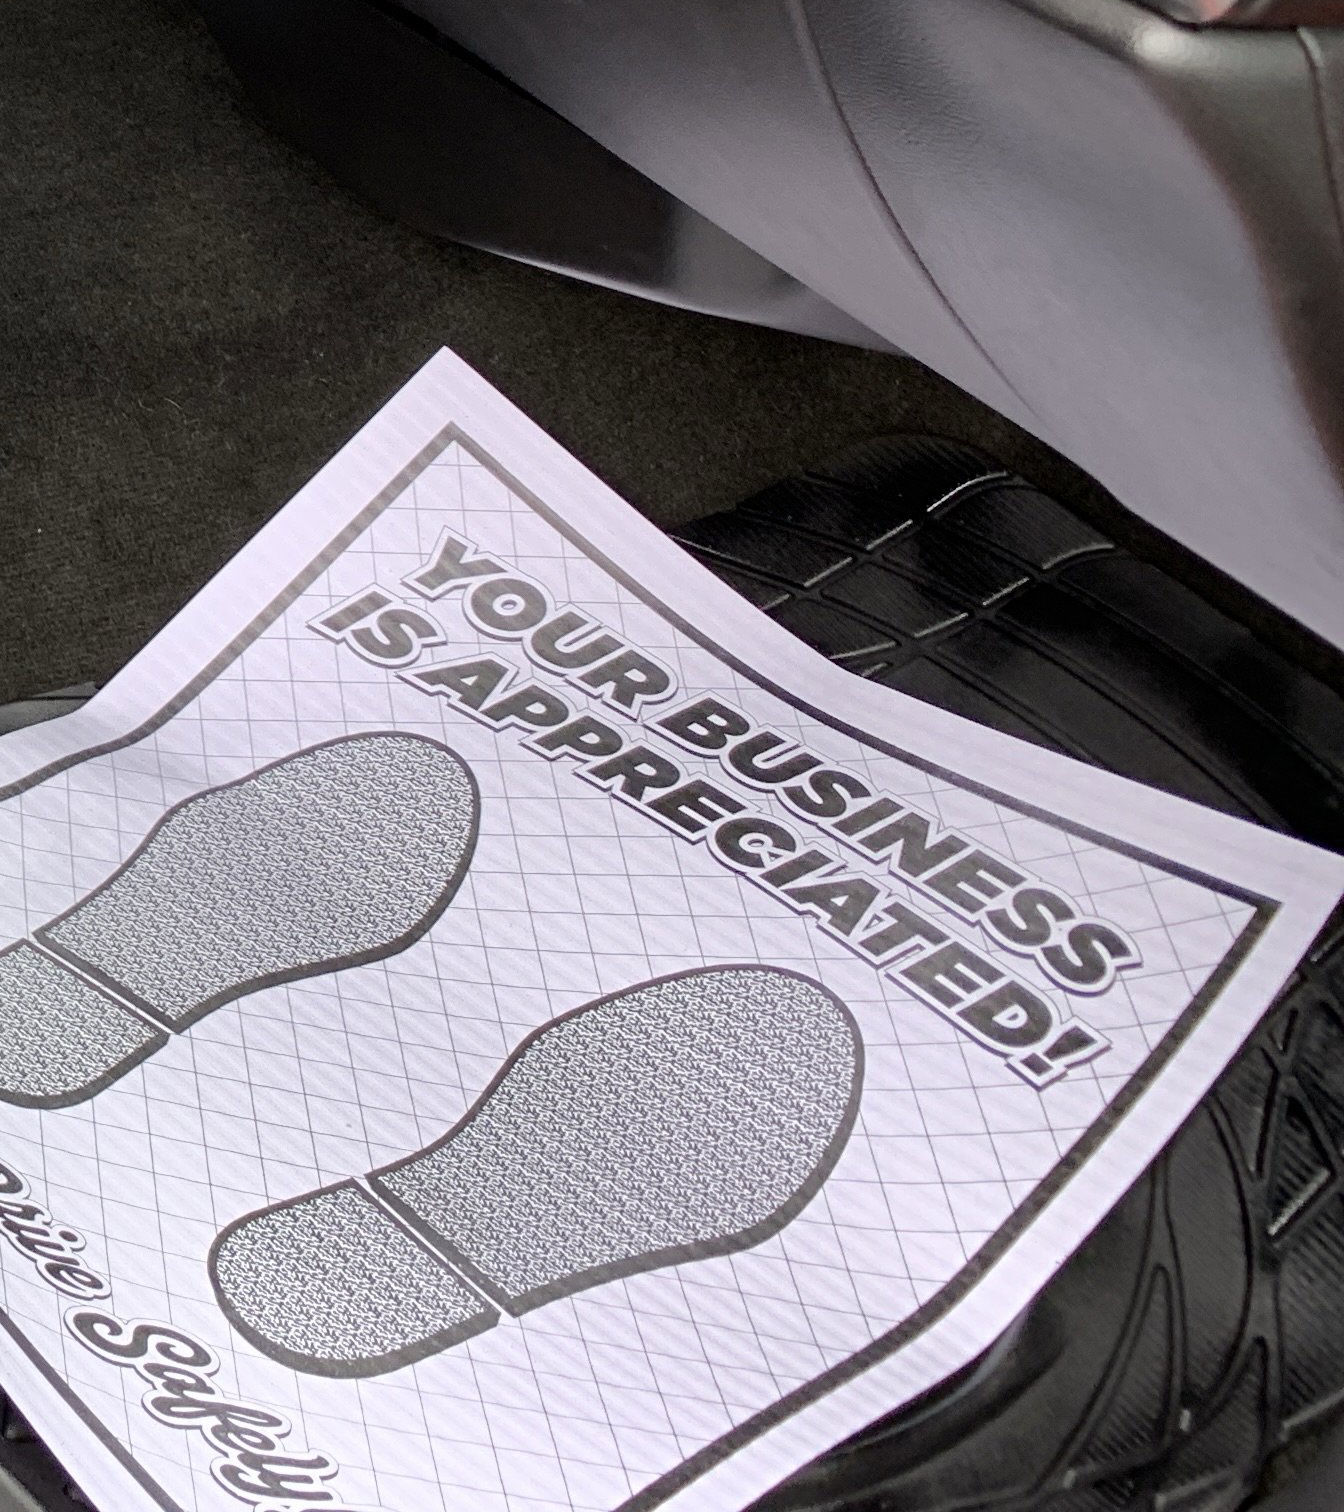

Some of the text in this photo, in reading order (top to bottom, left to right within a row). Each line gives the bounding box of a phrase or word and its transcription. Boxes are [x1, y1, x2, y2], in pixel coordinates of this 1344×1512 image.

[315, 588, 1107, 1086] IS APPRECIATED!
[408, 533, 1138, 996] YOUR BUSINESS
[65, 1306, 354, 1512] Safely
